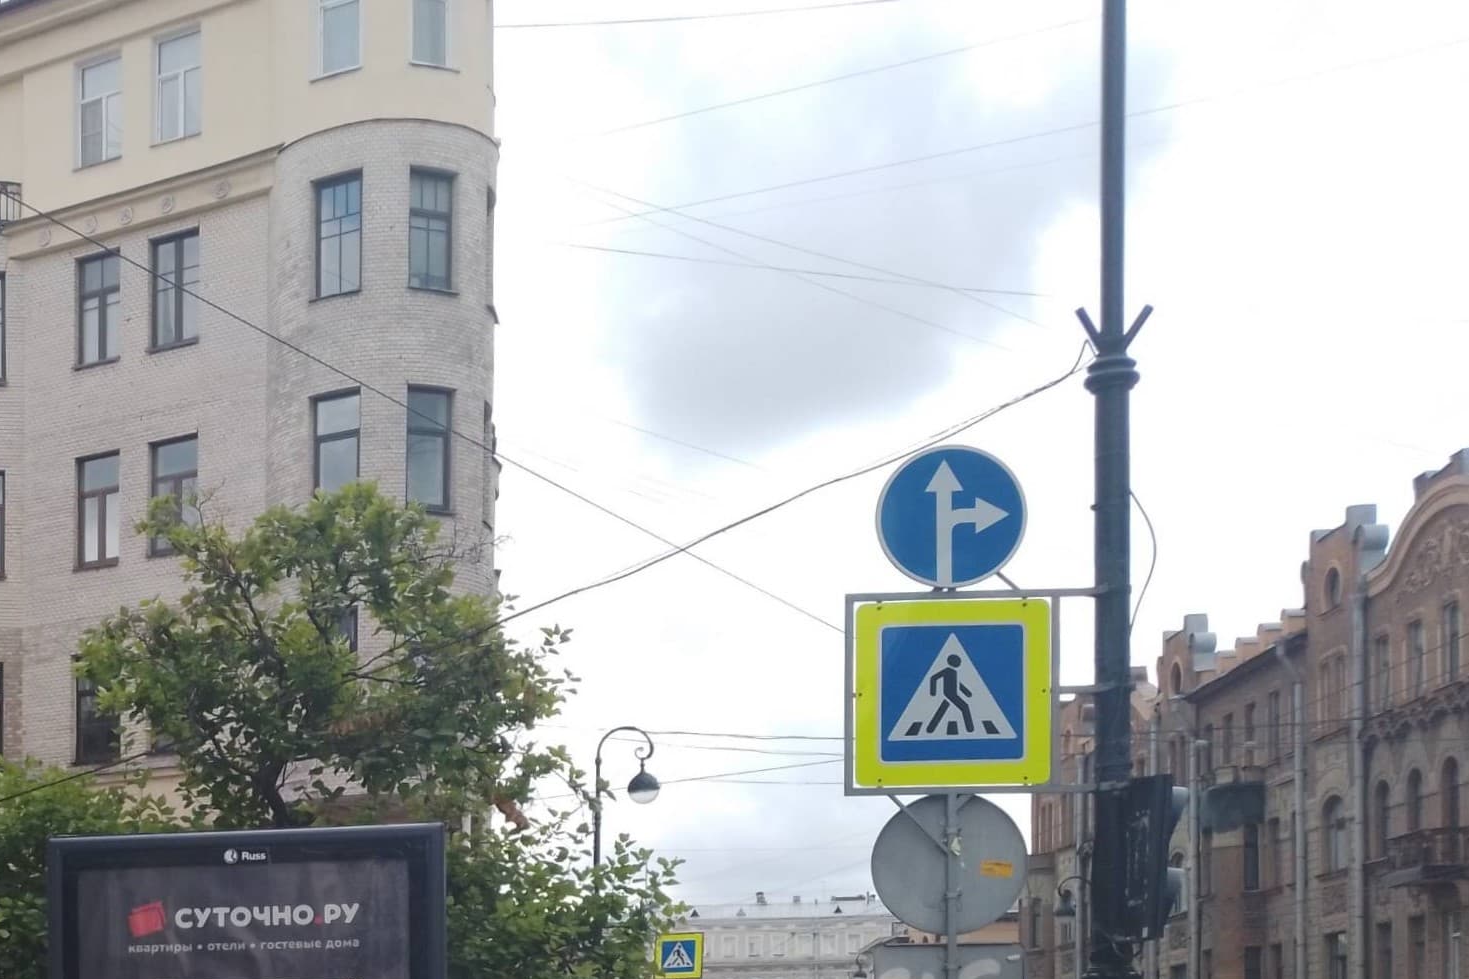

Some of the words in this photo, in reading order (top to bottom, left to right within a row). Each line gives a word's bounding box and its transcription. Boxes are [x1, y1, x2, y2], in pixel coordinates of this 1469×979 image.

[241, 851, 266, 861] Russ
[175, 903, 360, 929] СУТОЧНО.РУ
[128, 943, 193, 955] квартиры
[207, 941, 246, 951] отели
[260, 940, 322, 951] гостевые
[325, 938, 360, 950] дома
